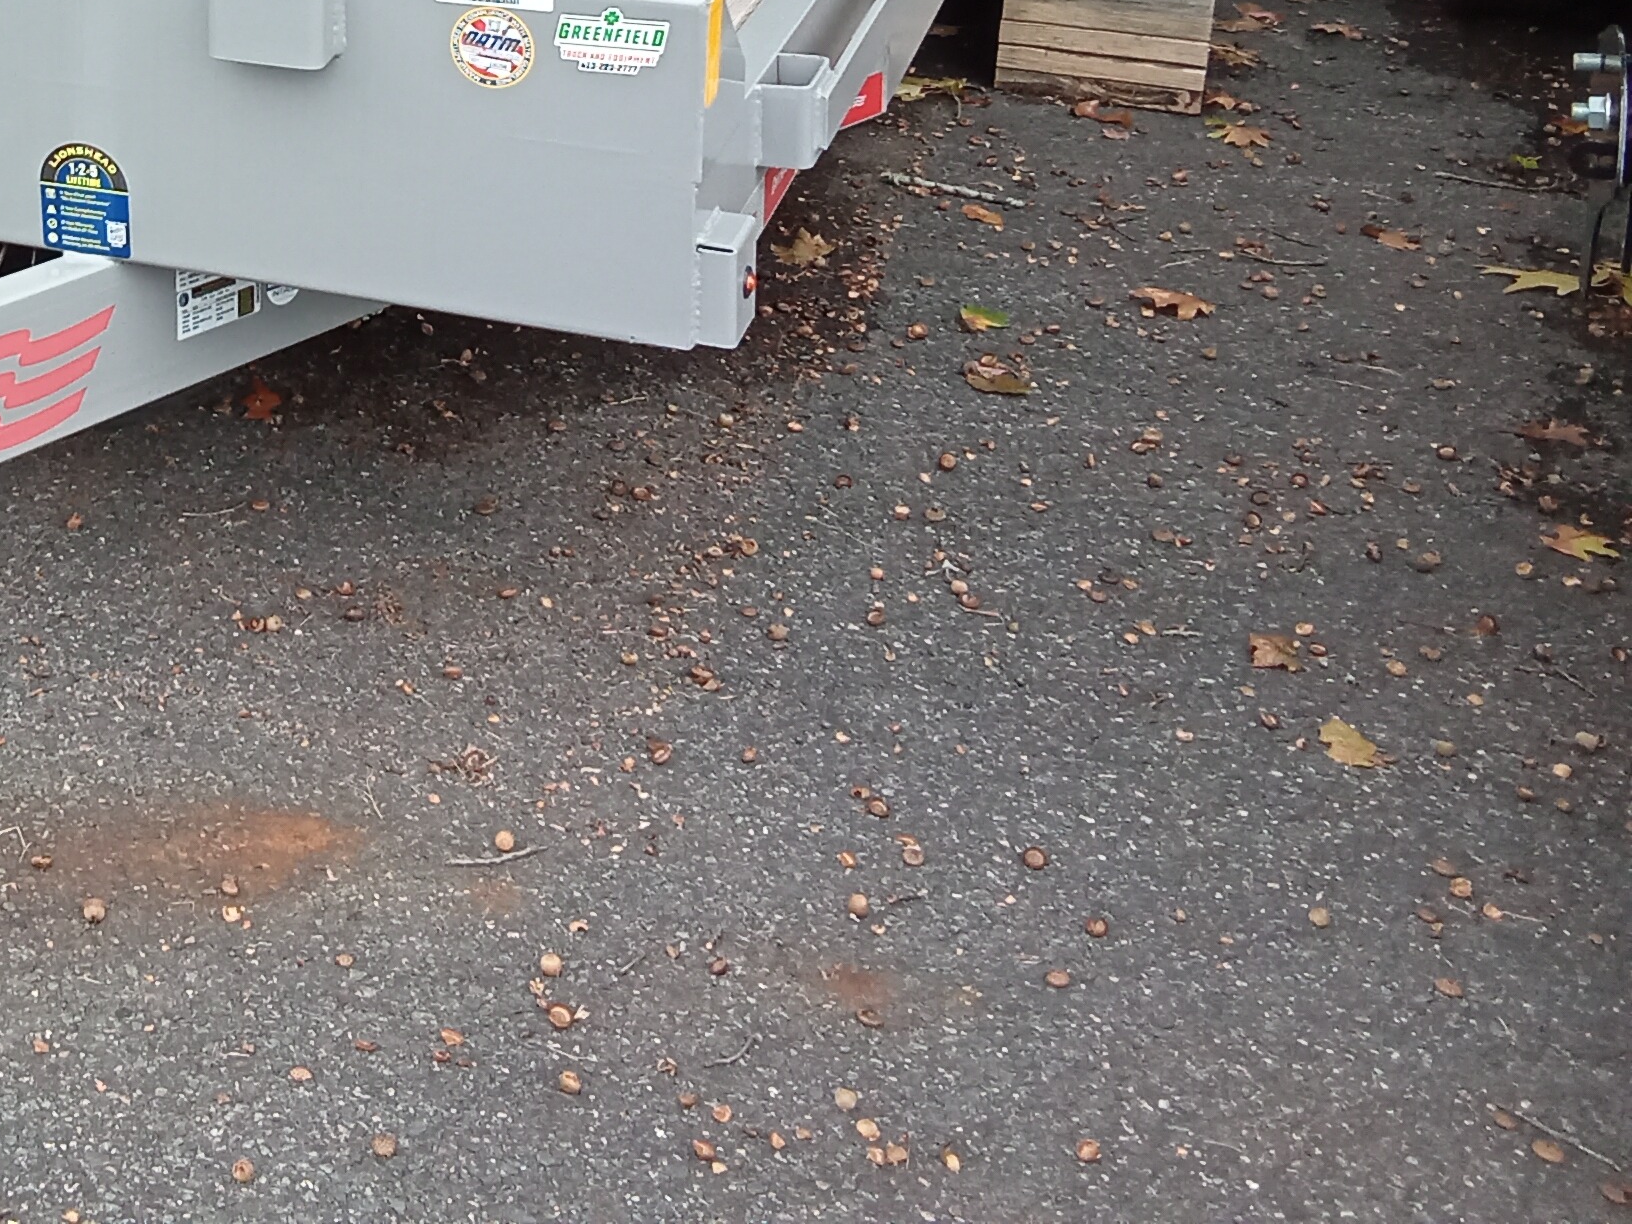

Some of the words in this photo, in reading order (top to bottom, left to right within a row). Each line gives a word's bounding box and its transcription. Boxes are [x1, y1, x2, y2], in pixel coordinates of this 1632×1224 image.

[558, 22, 665, 46] GREENFIELD
[48, 146, 117, 175] LIONSHEAD
[65, 174, 102, 188] LIFETIME
